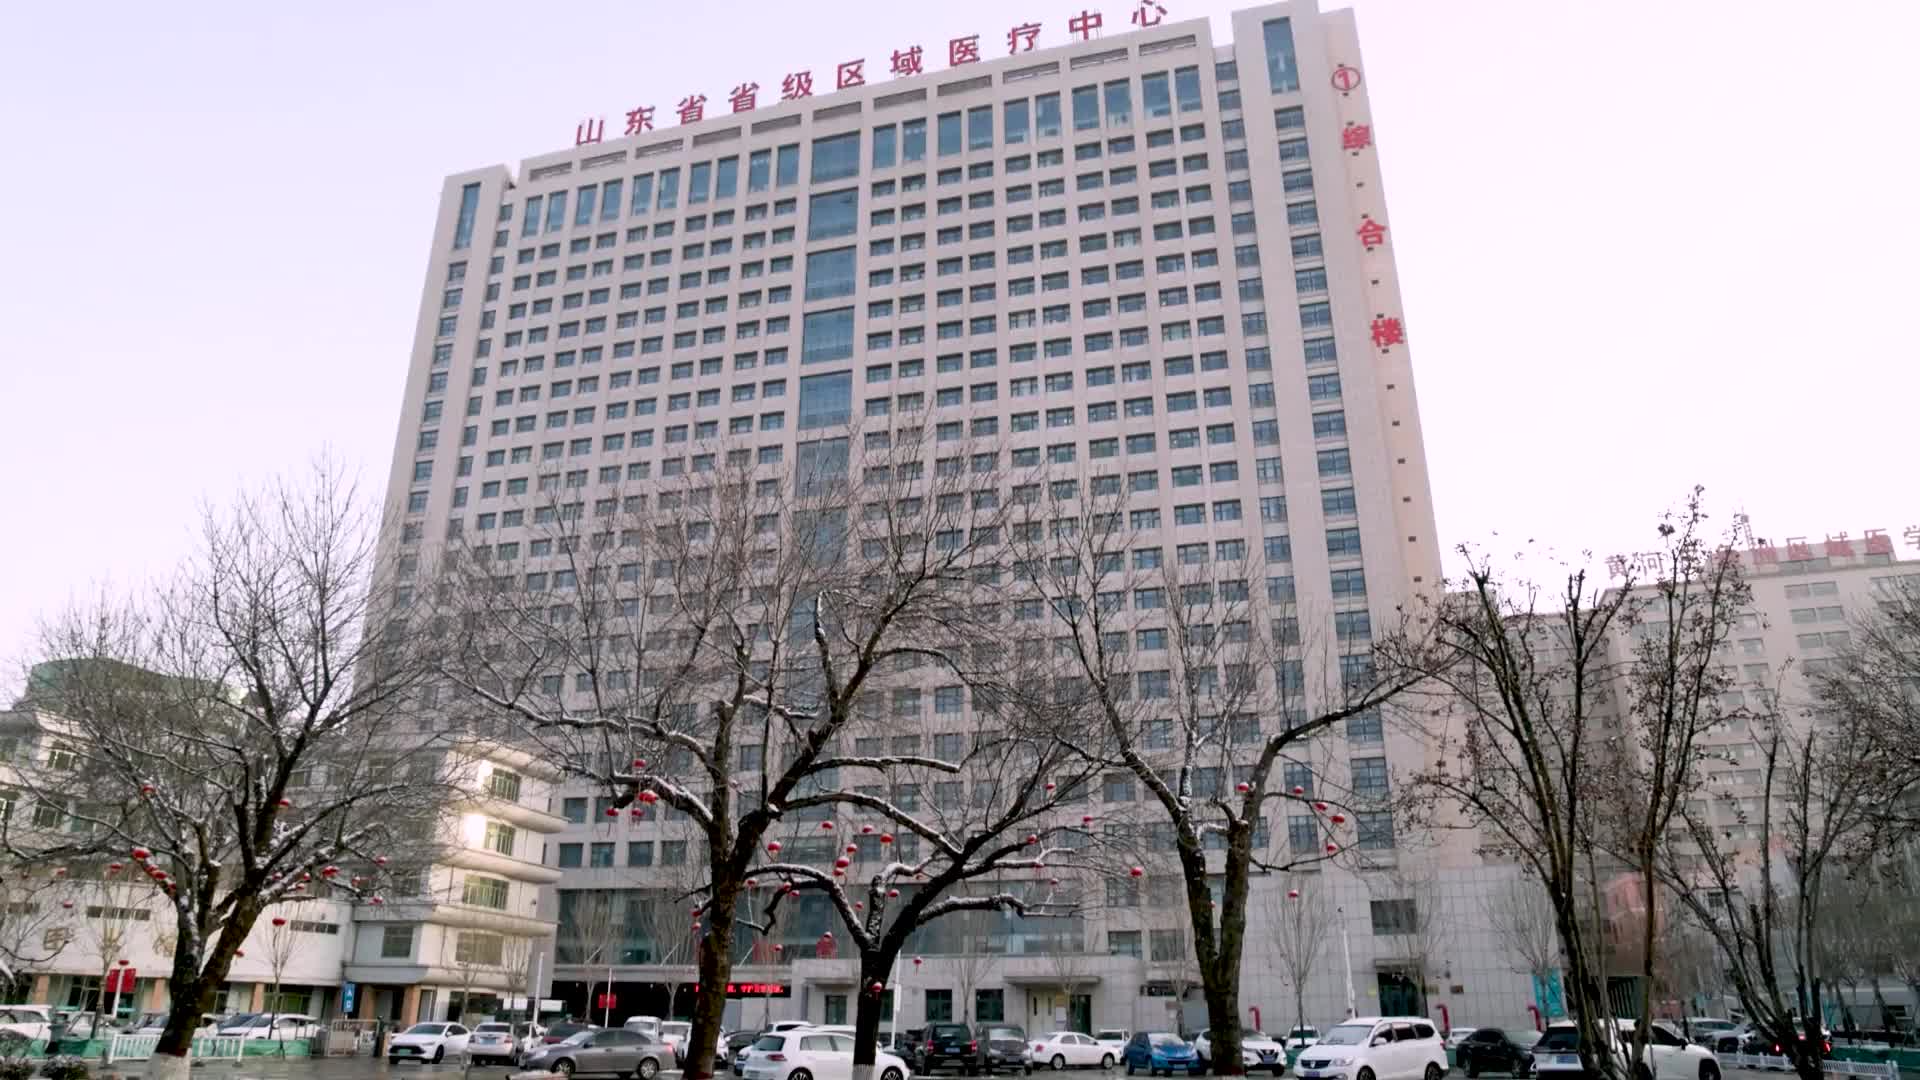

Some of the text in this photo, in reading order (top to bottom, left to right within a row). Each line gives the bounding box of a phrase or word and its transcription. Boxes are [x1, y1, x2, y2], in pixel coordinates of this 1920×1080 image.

[575, 0, 1168, 146] 山东省省级区域医疗中心
